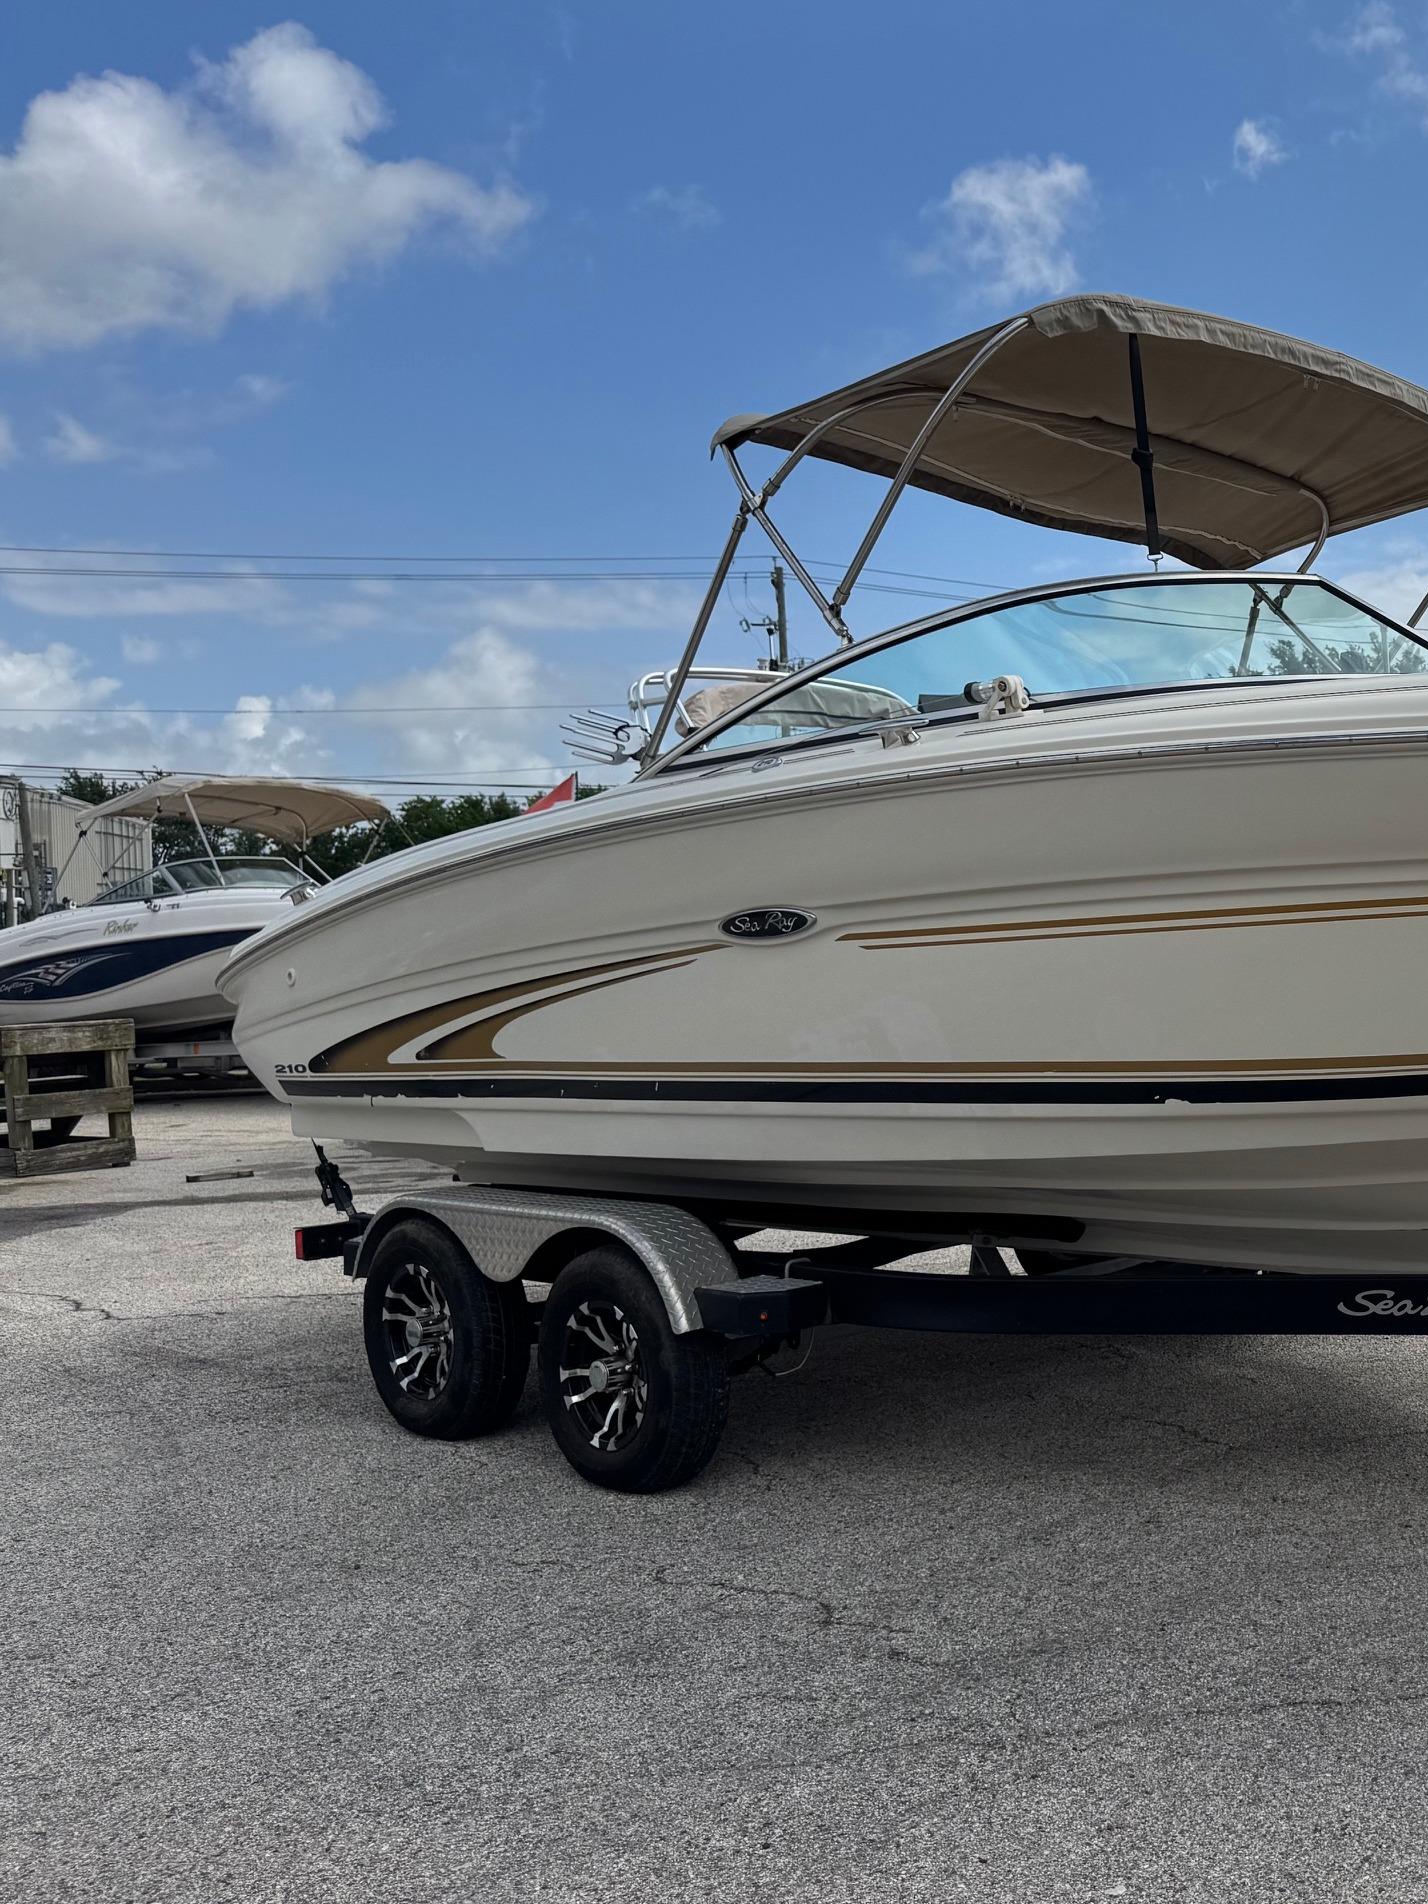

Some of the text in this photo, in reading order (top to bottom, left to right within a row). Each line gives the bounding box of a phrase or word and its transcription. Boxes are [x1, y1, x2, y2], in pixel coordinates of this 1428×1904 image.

[730, 911, 798, 933] Sea Ray
[274, 1063, 307, 1074] 210
[1337, 1289, 1424, 1317] Sea
